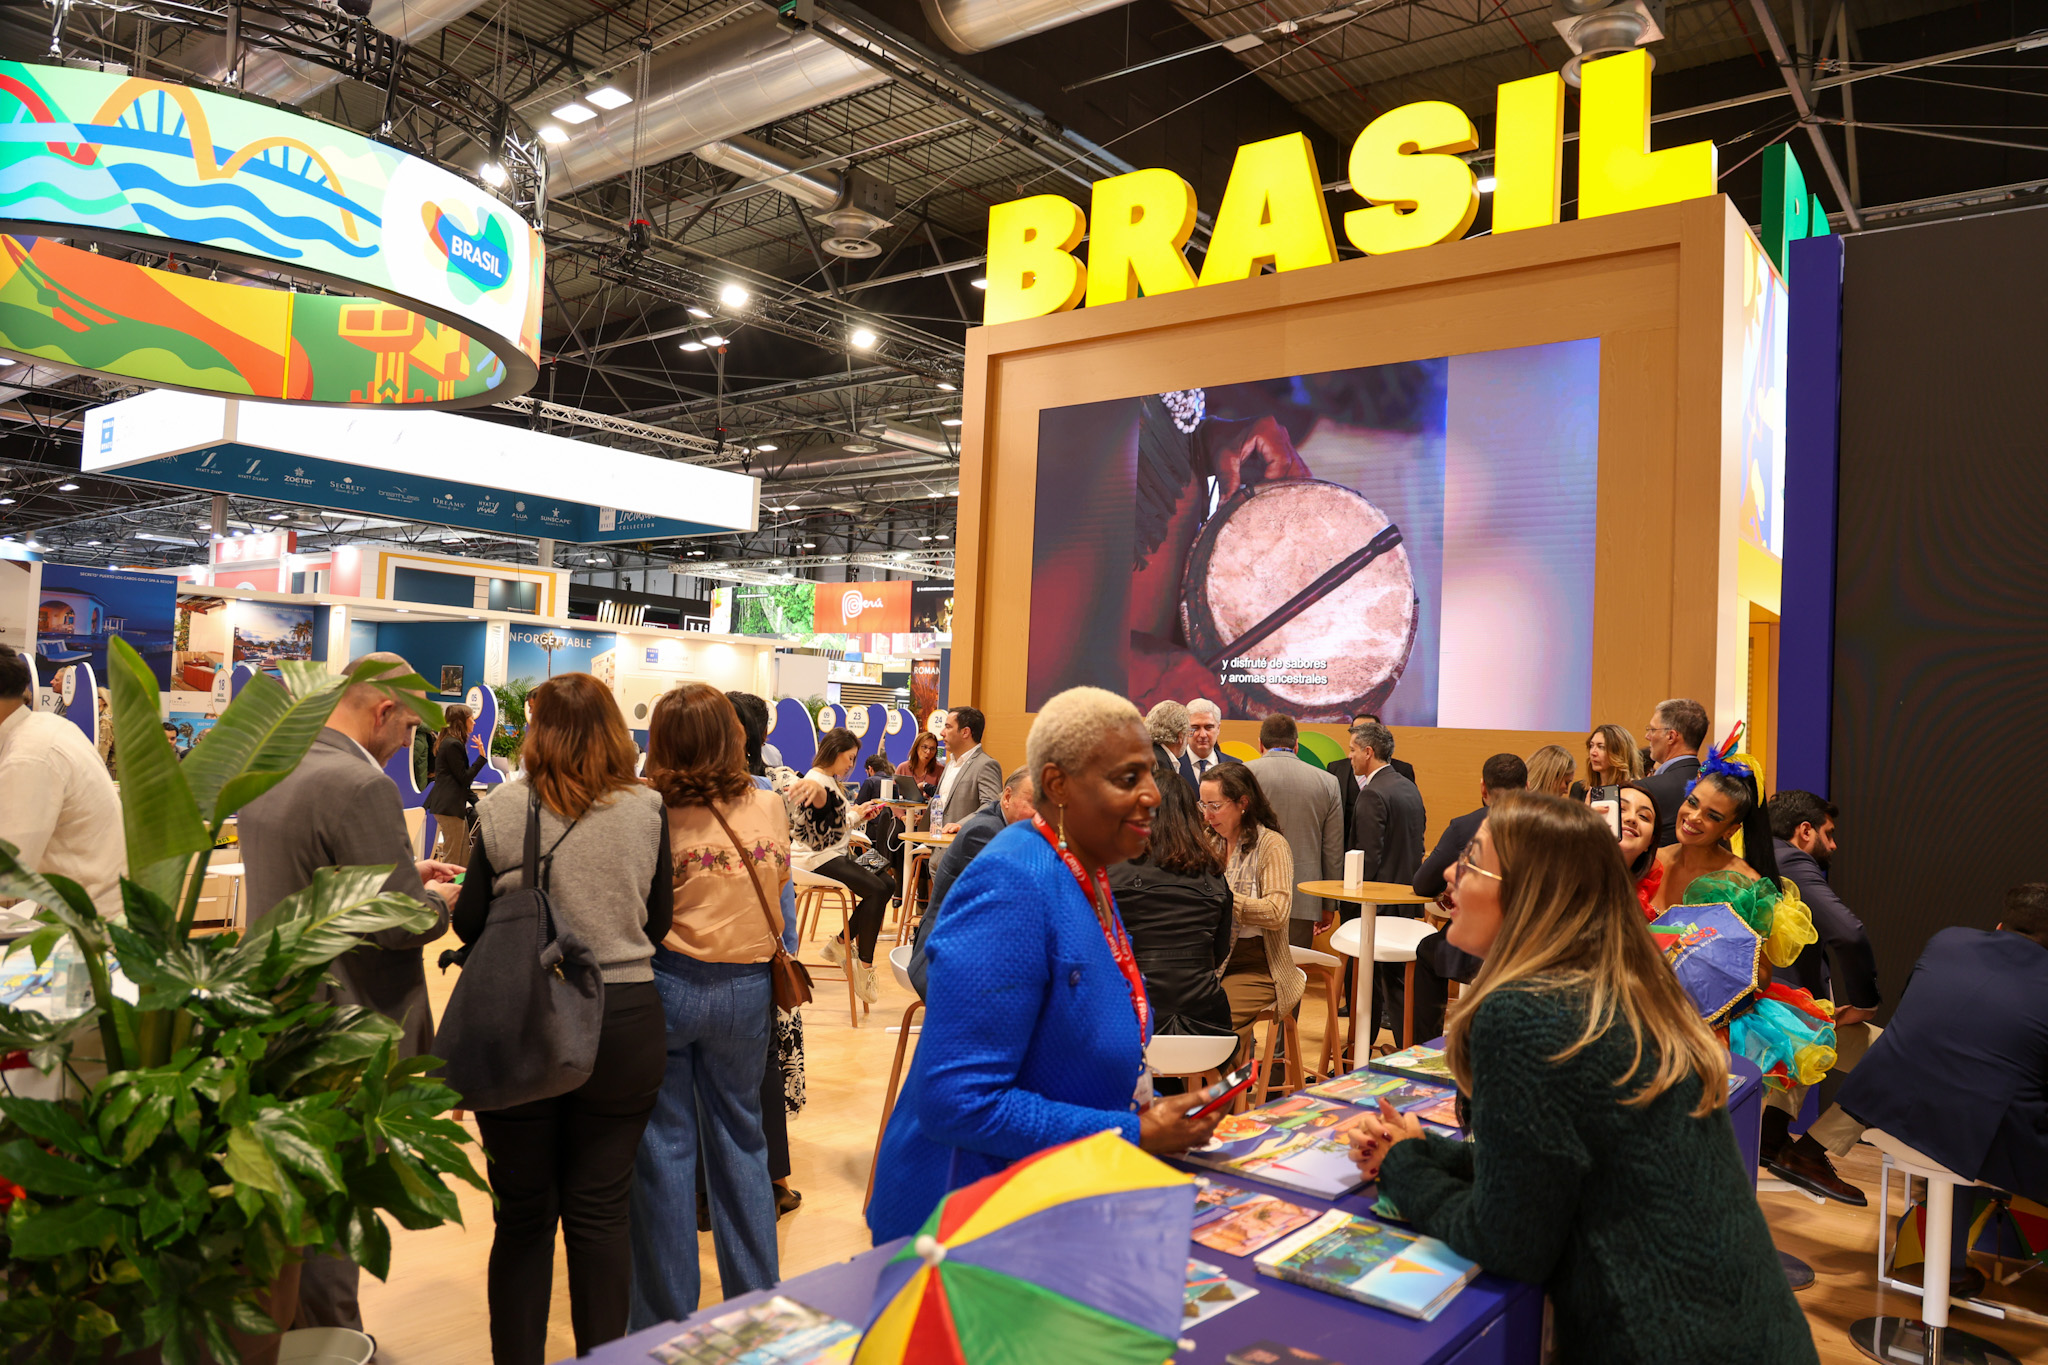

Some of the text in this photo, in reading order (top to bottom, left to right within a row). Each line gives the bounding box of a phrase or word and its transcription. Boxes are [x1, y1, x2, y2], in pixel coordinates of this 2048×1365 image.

[983, 48, 1718, 326] BRASIL
[451, 234, 502, 278] BRASIL
[329, 480, 365, 492] SECRETS
[432, 497, 465, 509] DREAMS
[511, 512, 528, 520] ALUA
[540, 515, 571, 525] SUNSCAPE
[618, 522, 655, 531] COLLECTION
[841, 590, 884, 626] Perú
[1221, 657, 1327, 670] y disfruté de sabores
[218, 679, 226, 691] 18
[1220, 673, 1328, 685] y aromas ancestrales
[823, 711, 830, 719] 09
[853, 712, 862, 720] 23
[890, 714, 897, 722] 10
[934, 716, 943, 724] 24
